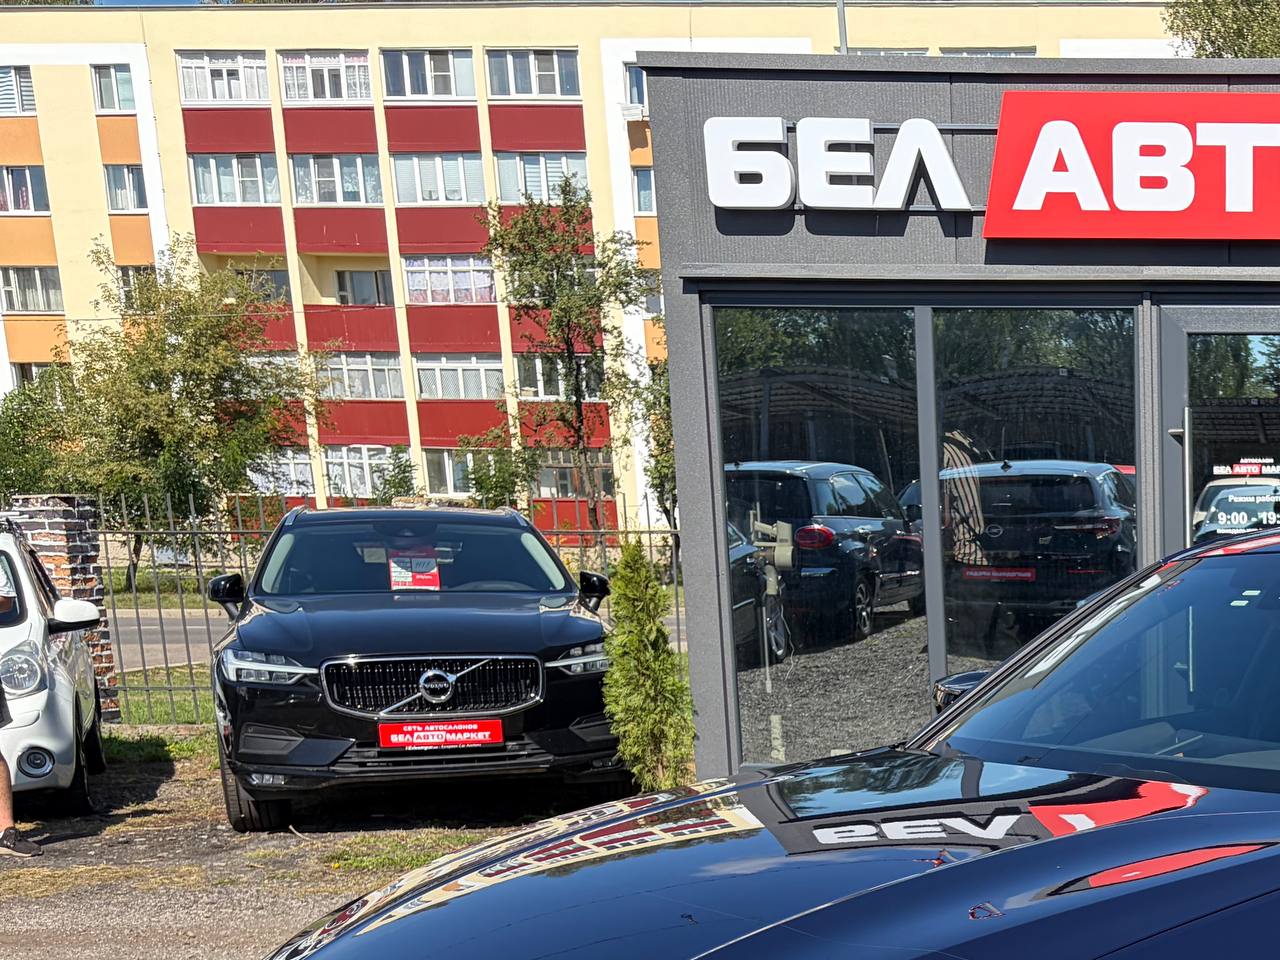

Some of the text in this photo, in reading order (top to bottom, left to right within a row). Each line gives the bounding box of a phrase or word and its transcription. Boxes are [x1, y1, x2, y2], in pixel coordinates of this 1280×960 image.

[703, 116, 973, 212] БЕЛ
[1213, 465, 1232, 475] БЕЛ
[1233, 465, 1259, 473] АВТО
[1228, 495, 1255, 503] Режим
[1217, 511, 1248, 525] 9:00
[390, 731, 491, 744] БЕЛ АВТО МАРКЕТ
